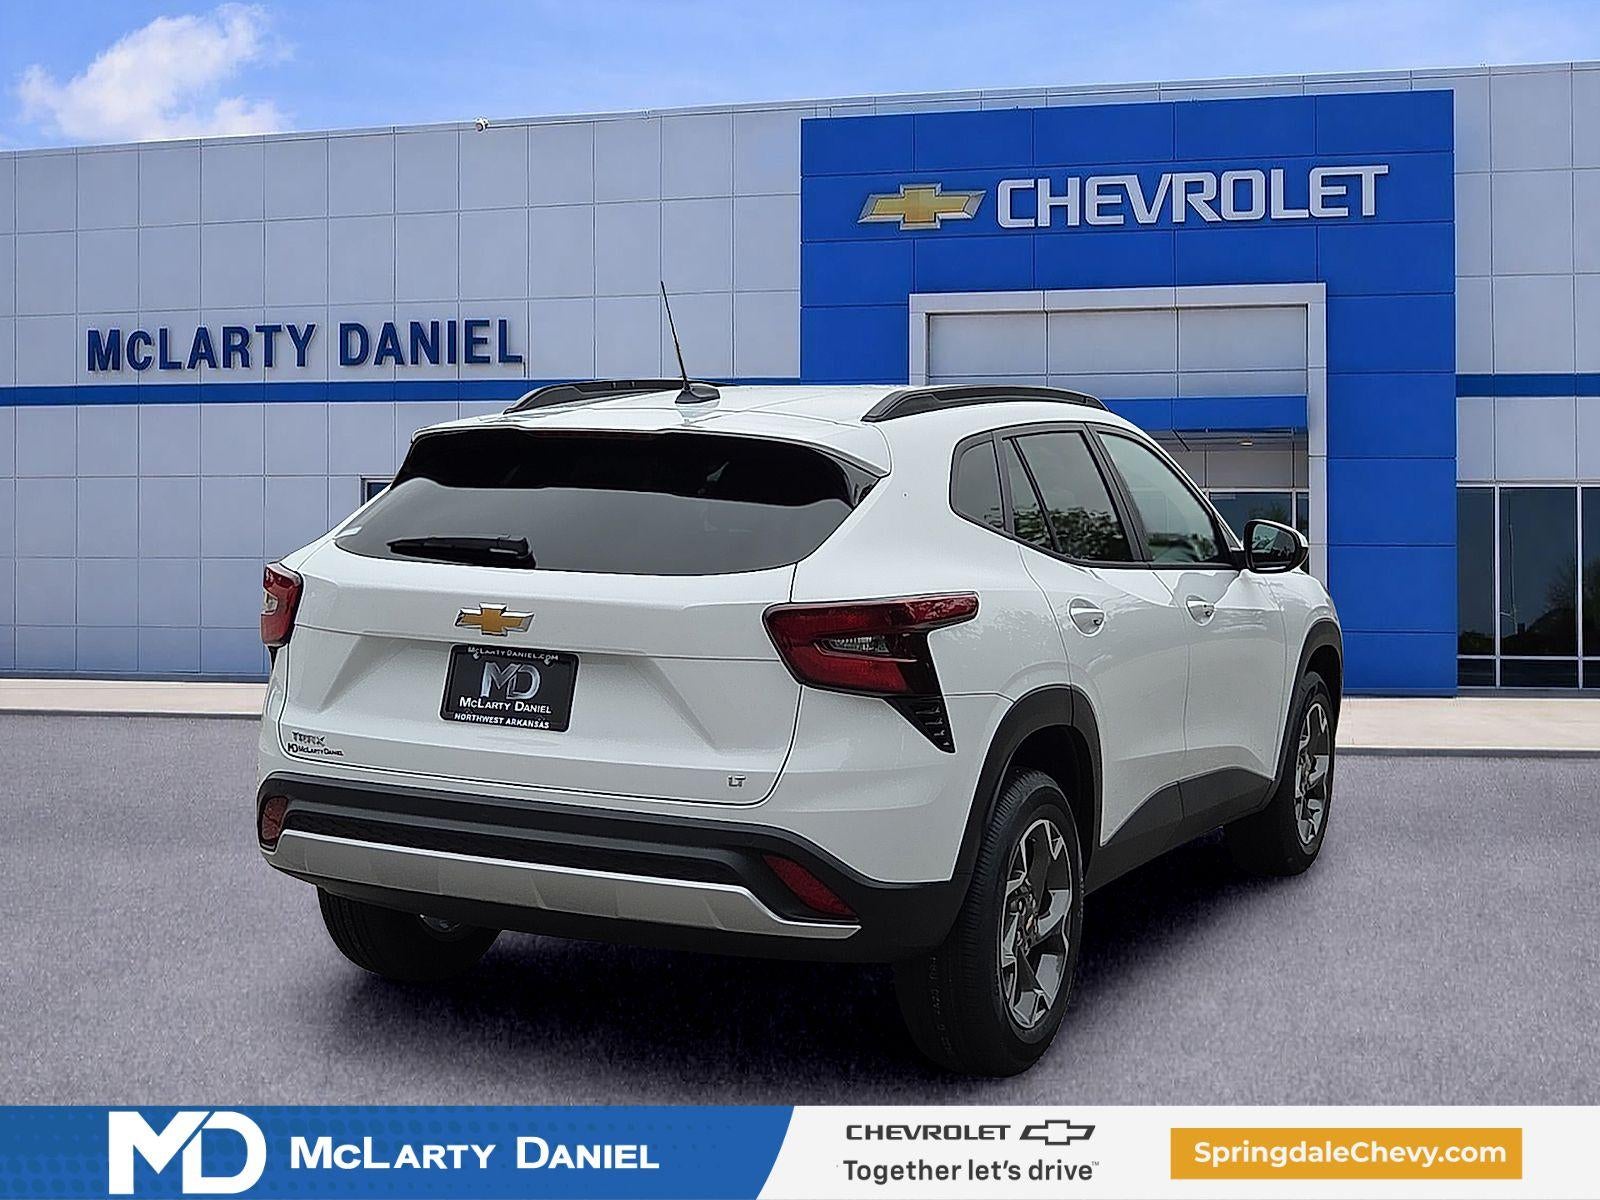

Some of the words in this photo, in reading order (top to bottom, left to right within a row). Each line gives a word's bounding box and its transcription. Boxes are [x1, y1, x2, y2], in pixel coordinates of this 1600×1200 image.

[997, 164, 1389, 228] CHEVROLET
[87, 323, 317, 371] MCLARTY
[339, 319, 523, 368] DANIEL
[480, 661, 541, 700] MD
[514, 700, 552, 714] DANIEL
[454, 713, 504, 724] NORTHWEST
[505, 717, 550, 729] ARKANSAS
[728, 774, 747, 788] LT
